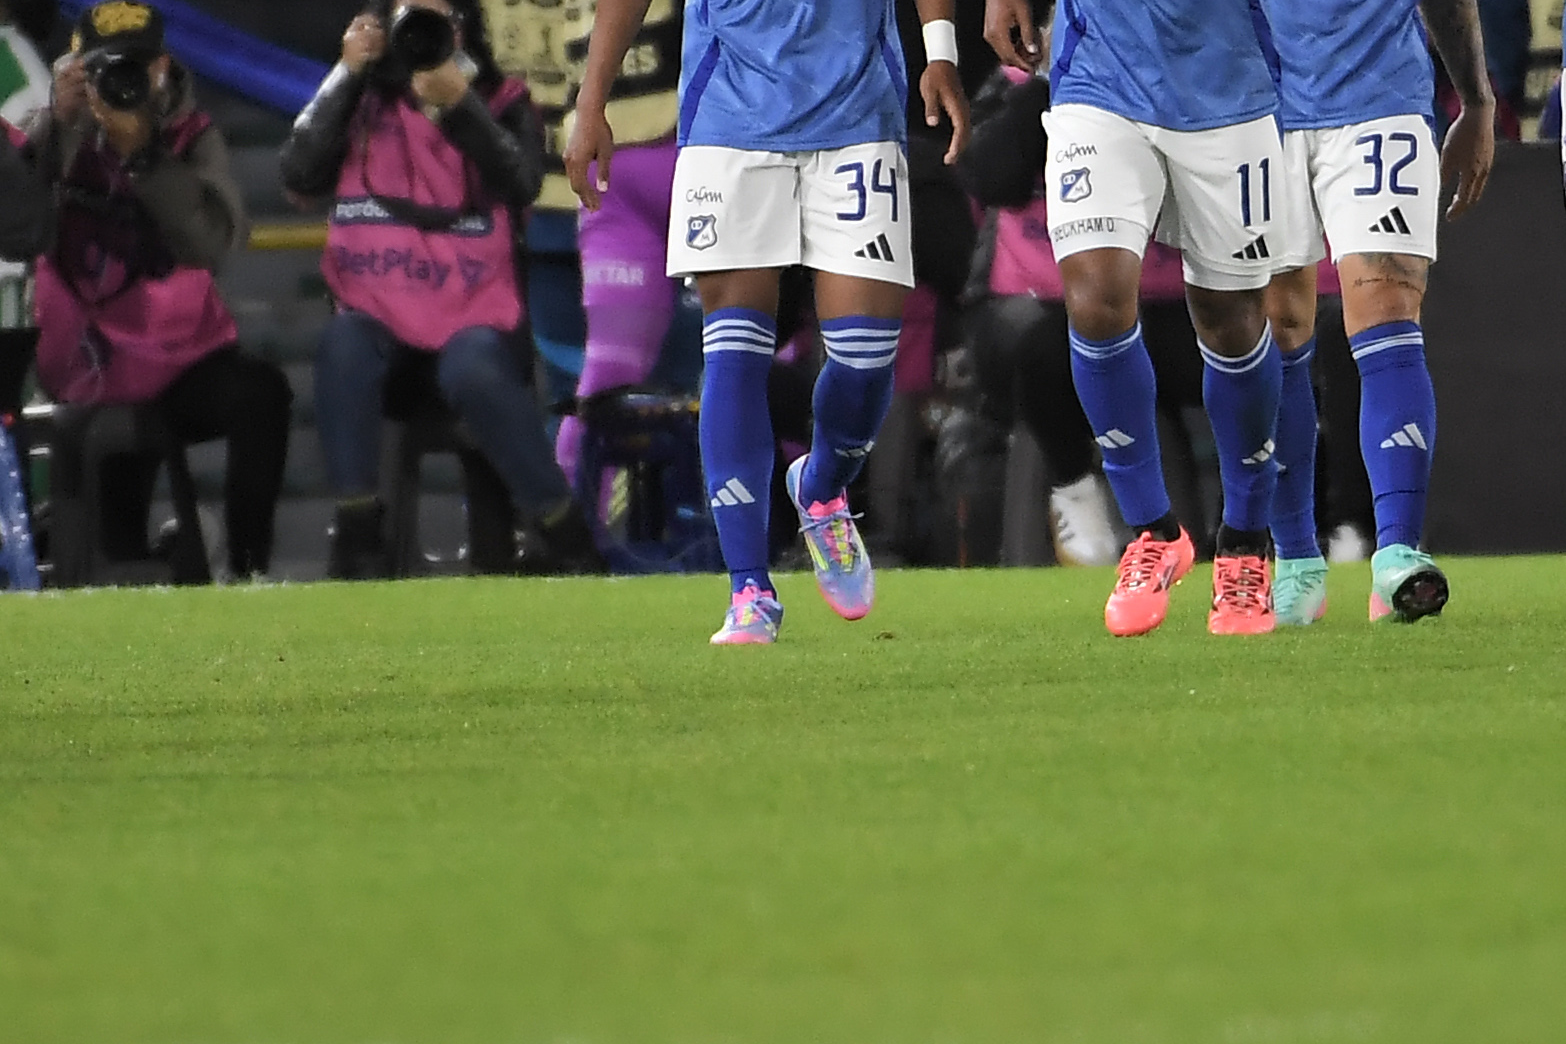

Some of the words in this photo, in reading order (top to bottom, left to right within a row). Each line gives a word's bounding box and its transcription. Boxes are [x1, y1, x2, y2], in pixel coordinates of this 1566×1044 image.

[834, 158, 898, 222] 34
[1237, 157, 1271, 227] 11
[1354, 132, 1419, 197] 32
